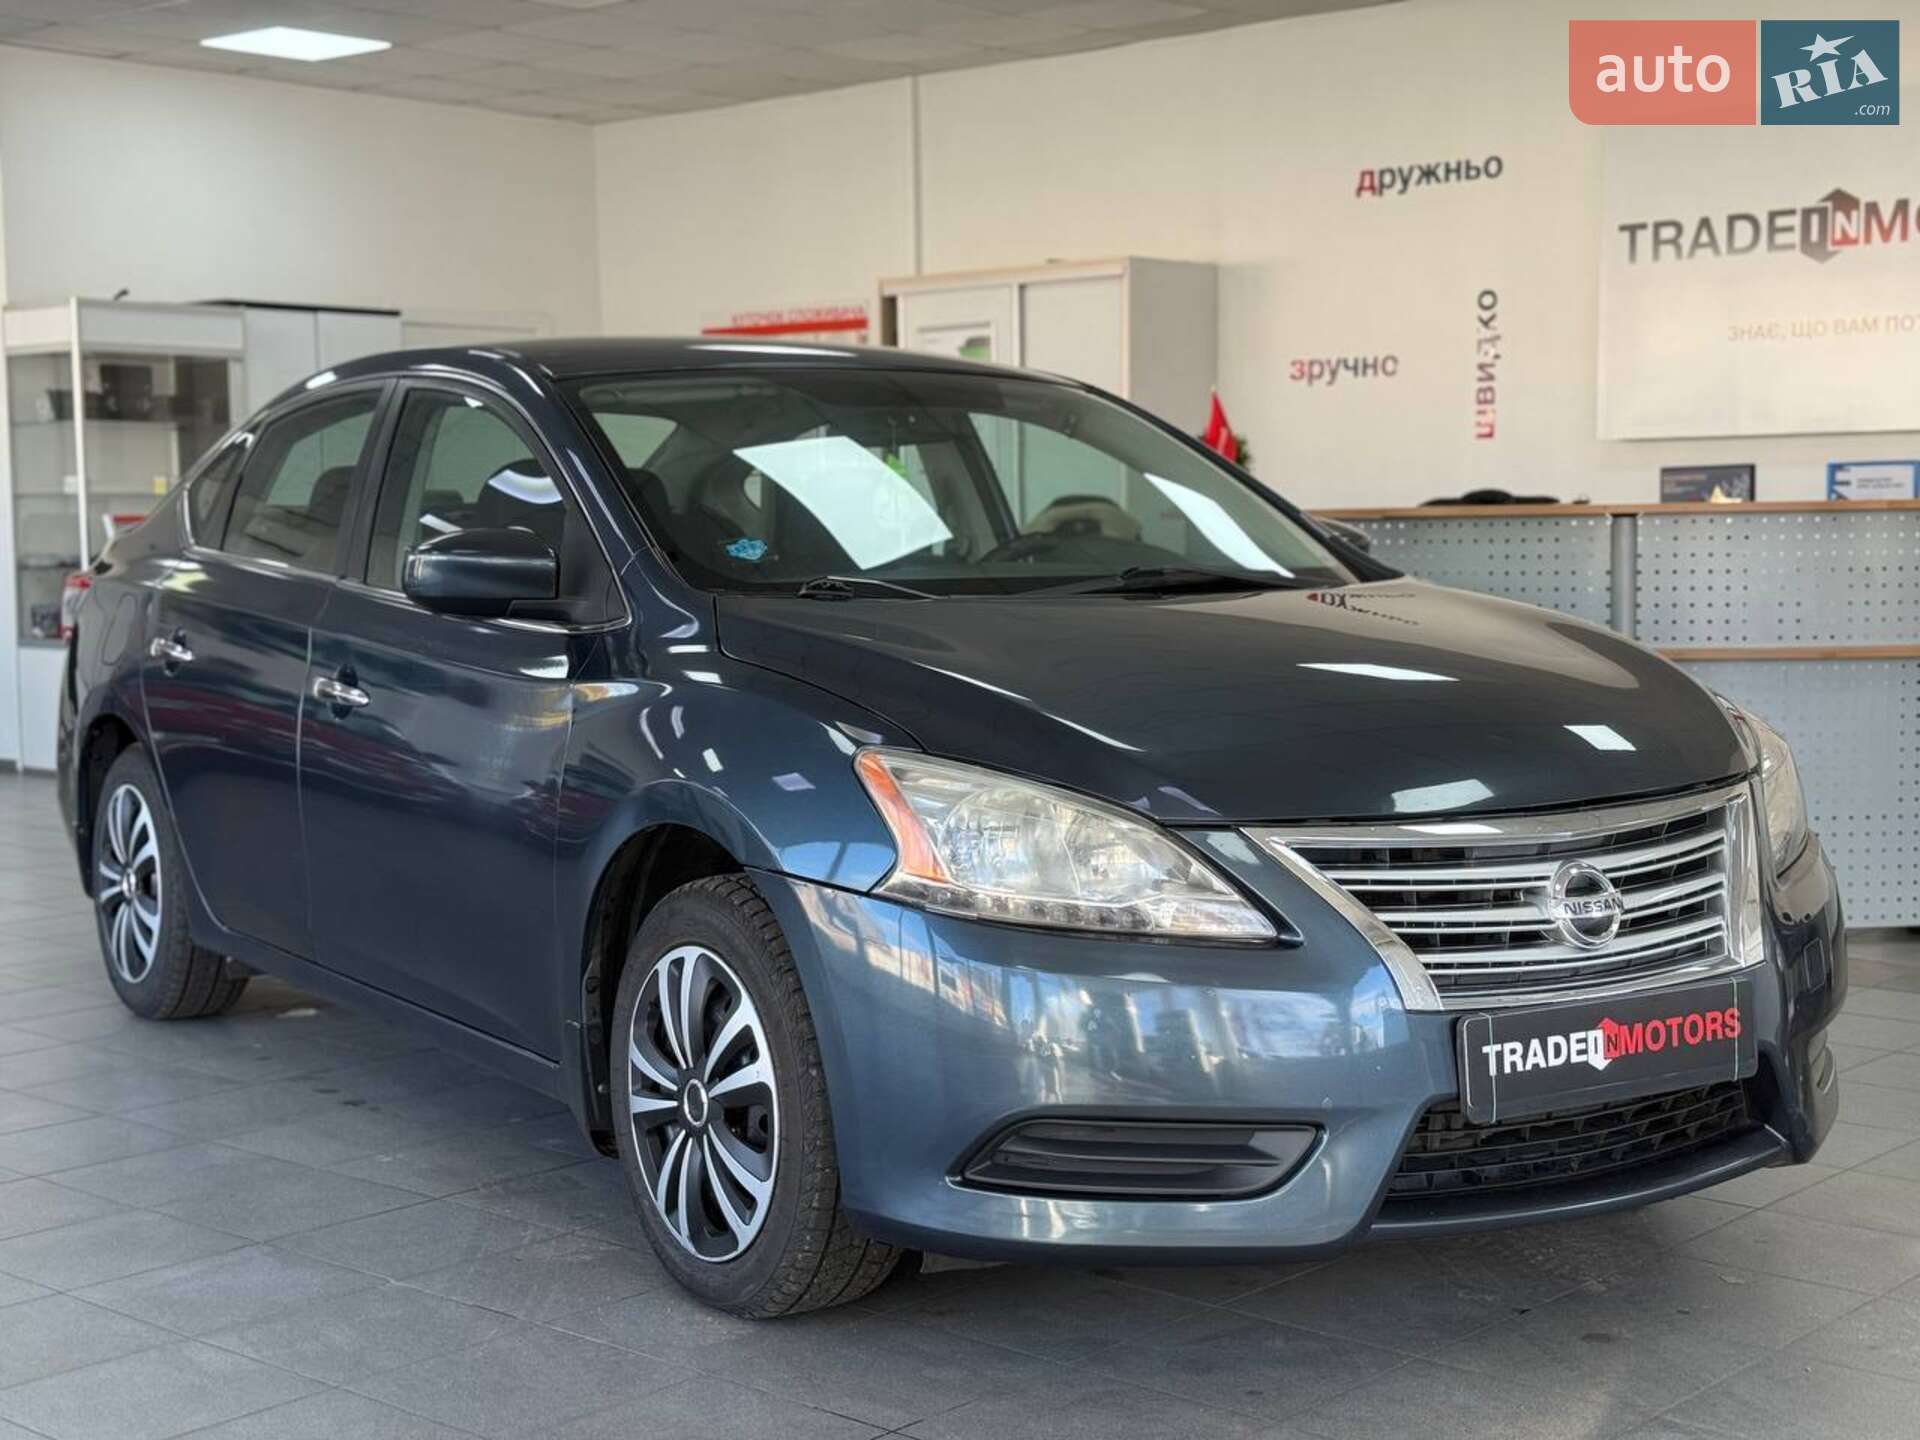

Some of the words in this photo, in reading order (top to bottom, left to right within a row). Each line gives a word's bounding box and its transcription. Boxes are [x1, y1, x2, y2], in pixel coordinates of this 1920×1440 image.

[1356, 155, 1504, 198] дружньо
[1834, 315, 1878, 335] ВАМ
[1885, 313, 1920, 333] ПО
[1289, 354, 1399, 386] зручно
[1563, 896, 1624, 915] NISSAN
